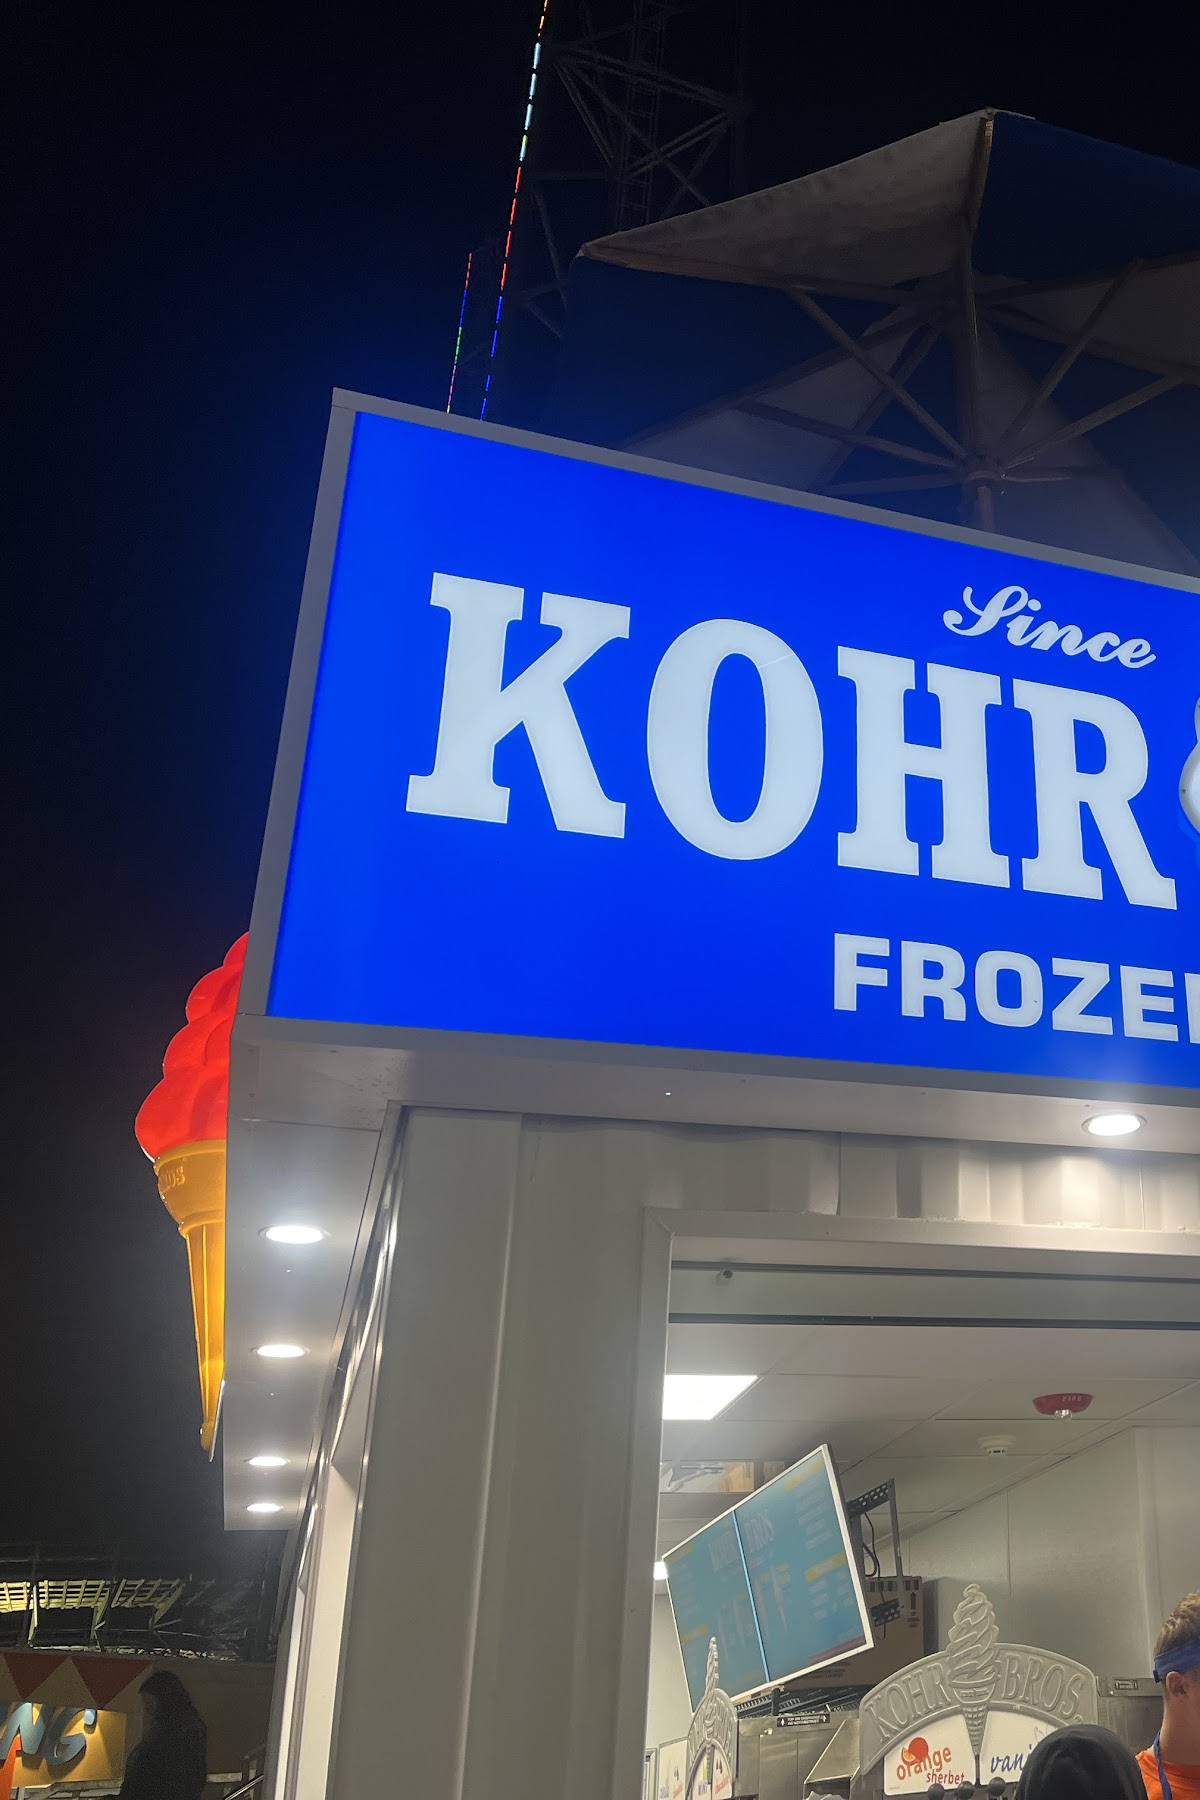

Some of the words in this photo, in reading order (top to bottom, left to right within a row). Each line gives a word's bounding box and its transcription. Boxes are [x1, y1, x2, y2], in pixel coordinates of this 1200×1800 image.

[943, 585, 1156, 669] Since
[406, 572, 1177, 910] KOHR
[864, 1661, 952, 1742] KOHR
[896, 1746, 952, 1781] orange
[926, 1770, 965, 1786] sherbet
